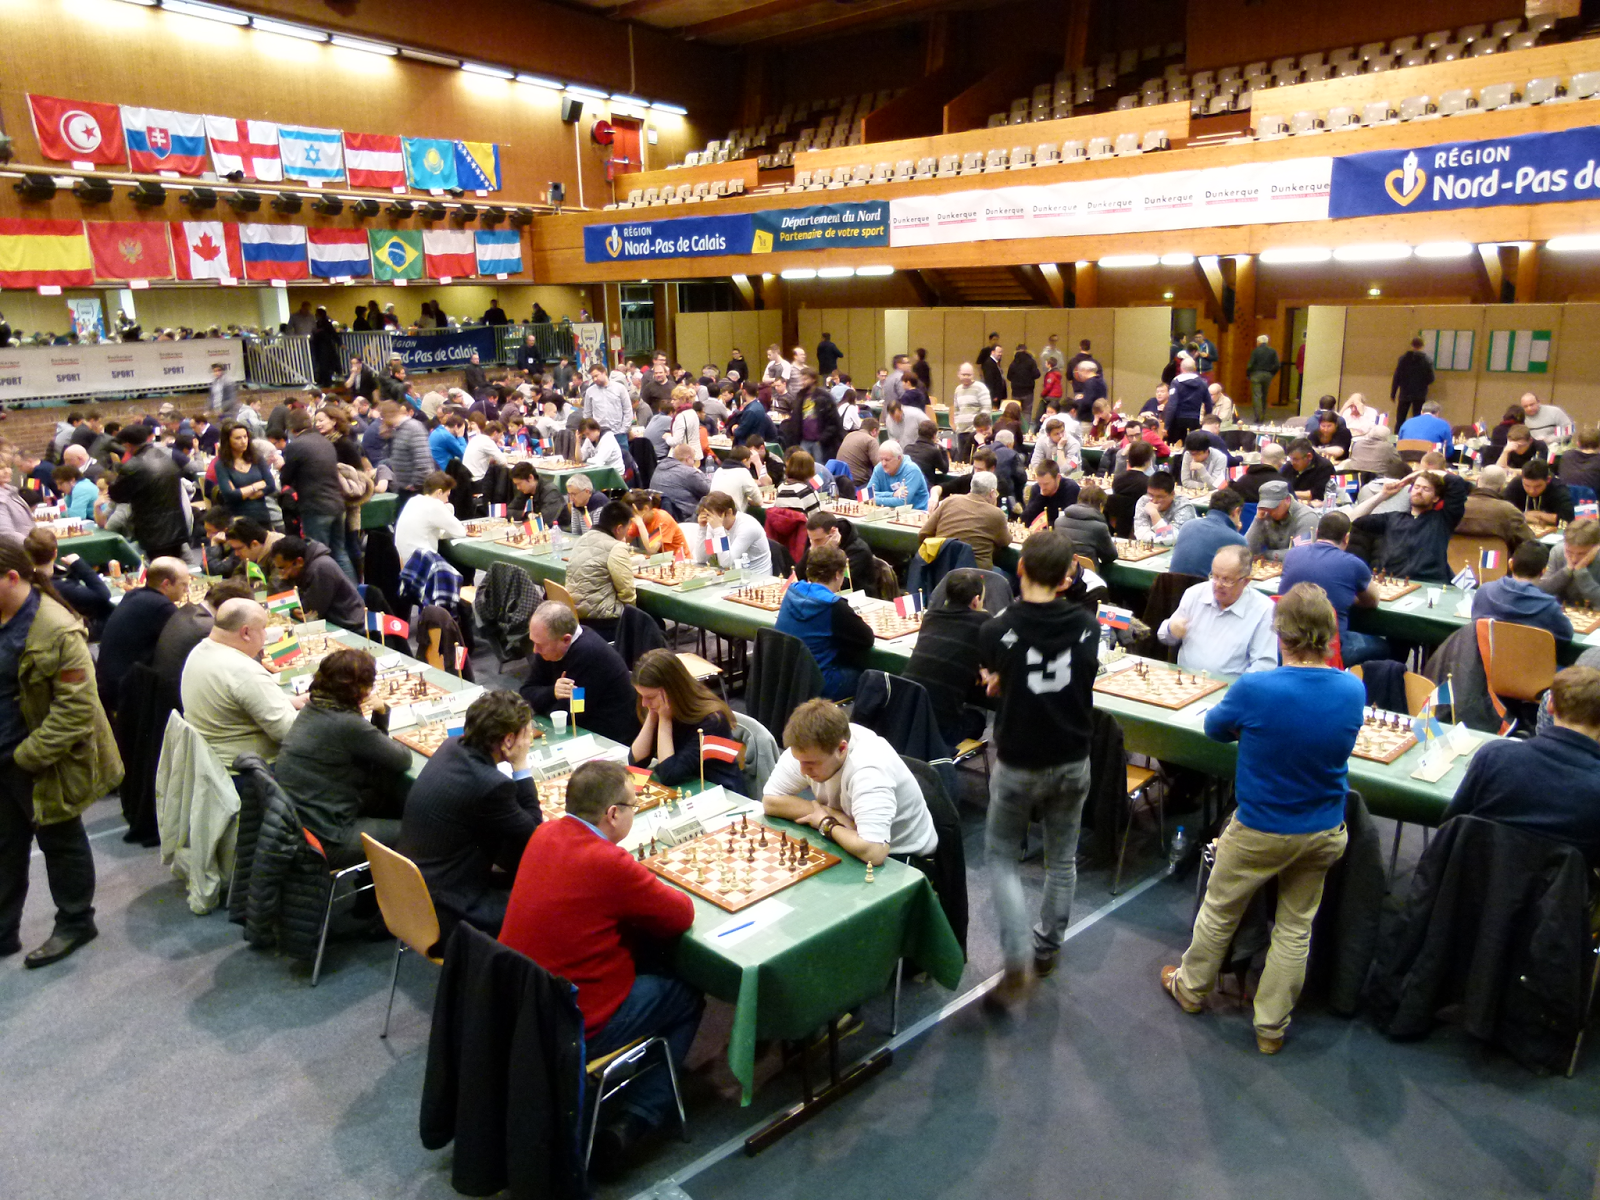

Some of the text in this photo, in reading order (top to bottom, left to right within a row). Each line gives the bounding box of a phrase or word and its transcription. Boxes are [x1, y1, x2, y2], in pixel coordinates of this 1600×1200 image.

[1434, 146, 1510, 168] RÉGION
[1271, 182, 1330, 193] Dunkerque
[1432, 167, 1569, 201] Nord-Pas
[1144, 193, 1194, 204] Dunkerque
[1205, 188, 1259, 198] Dunkerque
[1032, 203, 1078, 213] Dunkerque
[1087, 199, 1133, 210] Dunkerque
[937, 211, 977, 220] Dunkerque
[985, 206, 1024, 215] Dunkerque
[781, 208, 881, 230] Département du Nord
[893, 215, 930, 224] Dunkerque
[623, 226, 652, 237] RÉGION
[780, 229, 823, 242] Partenaire
[825, 227, 836, 238] de
[838, 227, 859, 238] votre
[861, 225, 885, 238] sport
[624, 233, 727, 256] Nord-Pas de Calais
[434, 348, 448, 361] de
[448, 344, 478, 360] Calais
[111, 370, 134, 379] SPORT
[163, 366, 185, 375] SPORT
[56, 373, 80, 383] SPORT
